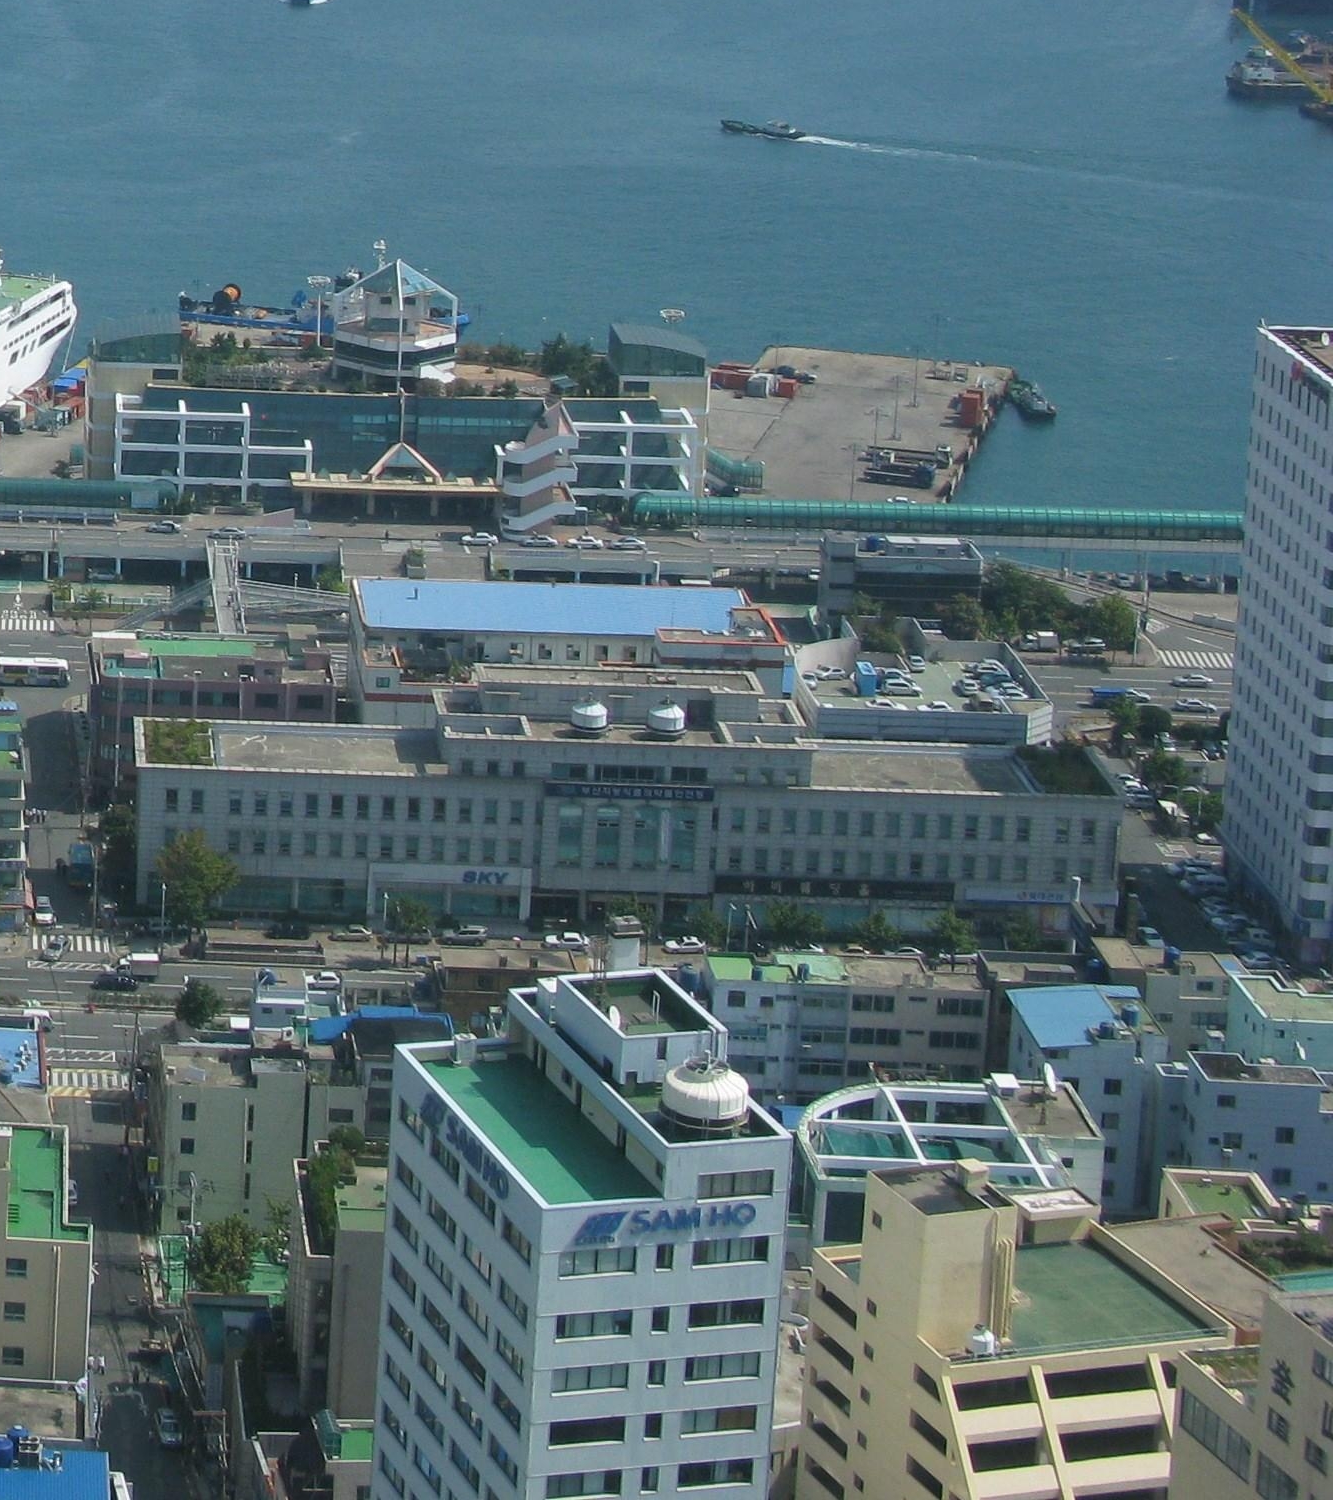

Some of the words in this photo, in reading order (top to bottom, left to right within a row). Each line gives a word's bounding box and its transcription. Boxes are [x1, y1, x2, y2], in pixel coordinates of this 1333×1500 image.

[462, 870, 509, 884] SKY
[445, 1115, 483, 1174] SAM
[483, 1150, 510, 1200] HO
[630, 1207, 702, 1235] SAM
[709, 1202, 757, 1227] HO
